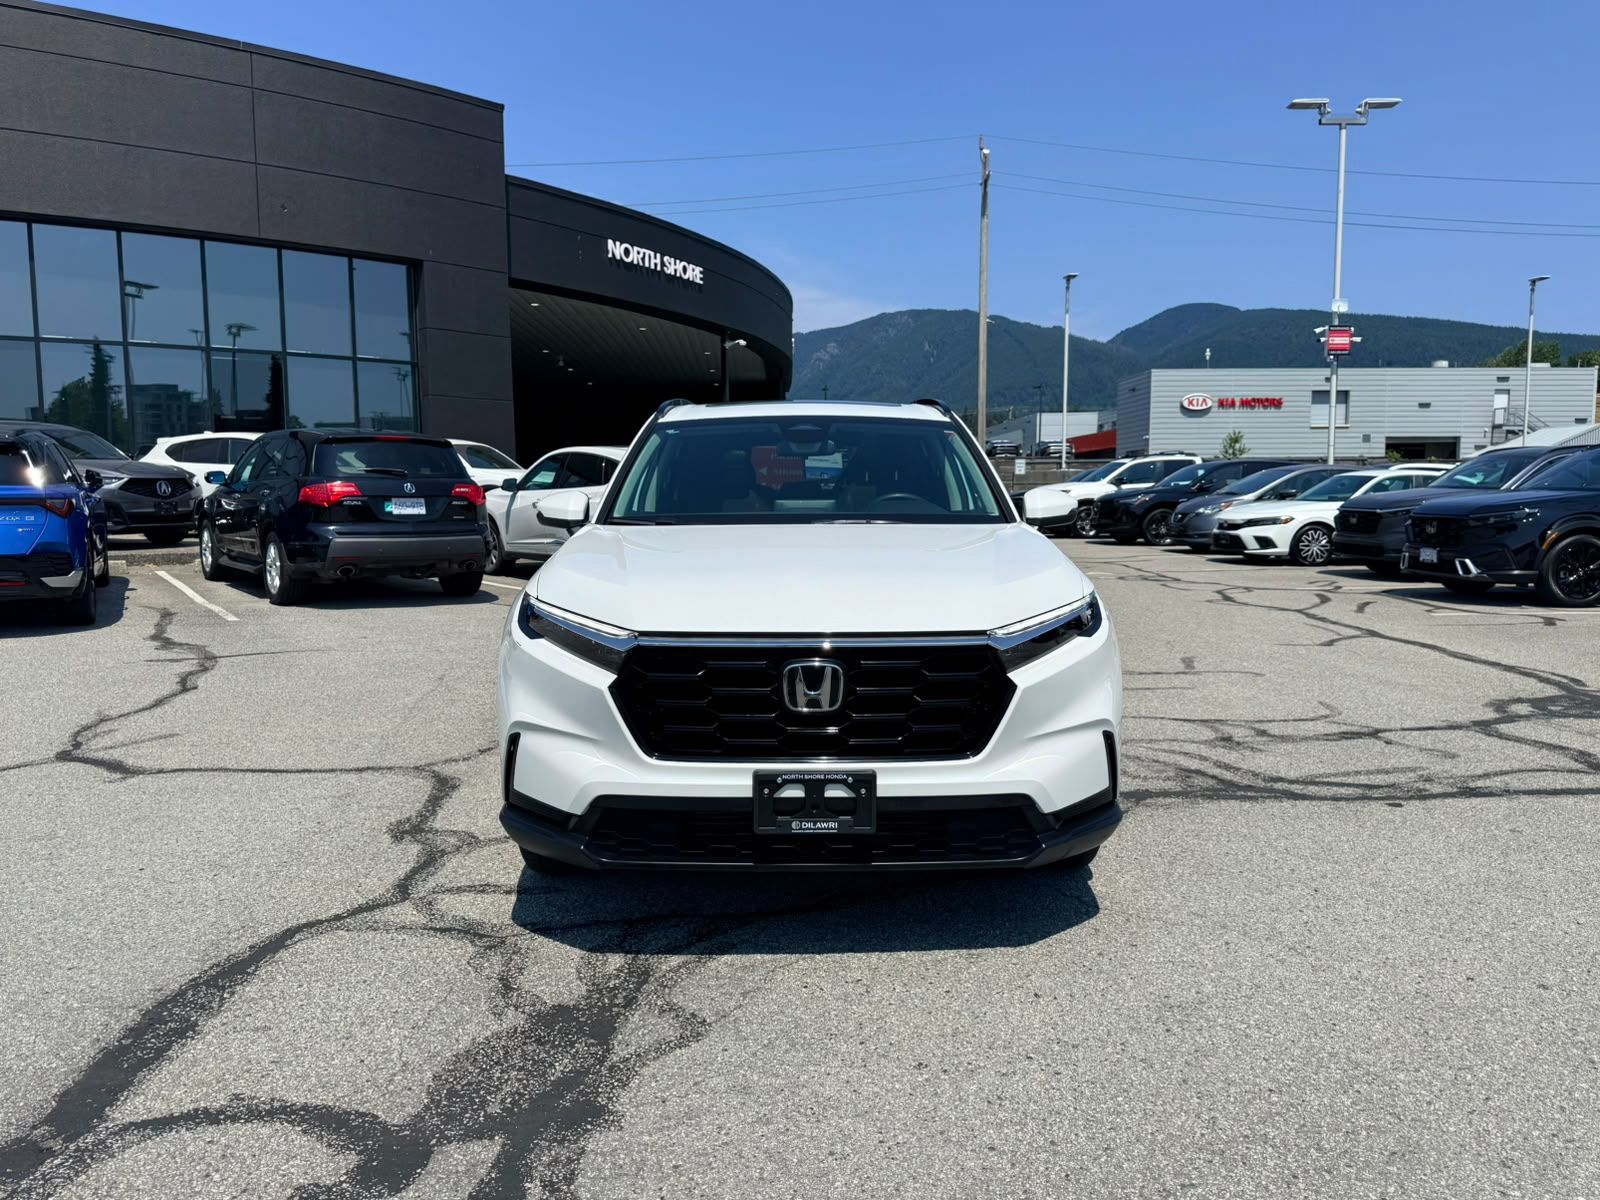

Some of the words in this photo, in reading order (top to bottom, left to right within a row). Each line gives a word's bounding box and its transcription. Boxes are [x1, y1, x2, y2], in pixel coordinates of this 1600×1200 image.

[607, 239, 661, 271] NORTH
[663, 255, 704, 284] SHORE
[1187, 398, 1209, 408] KIA
[1217, 397, 1236, 409] KIA
[1239, 397, 1284, 409] MOTORS
[801, 821, 838, 829] DILAWRI
